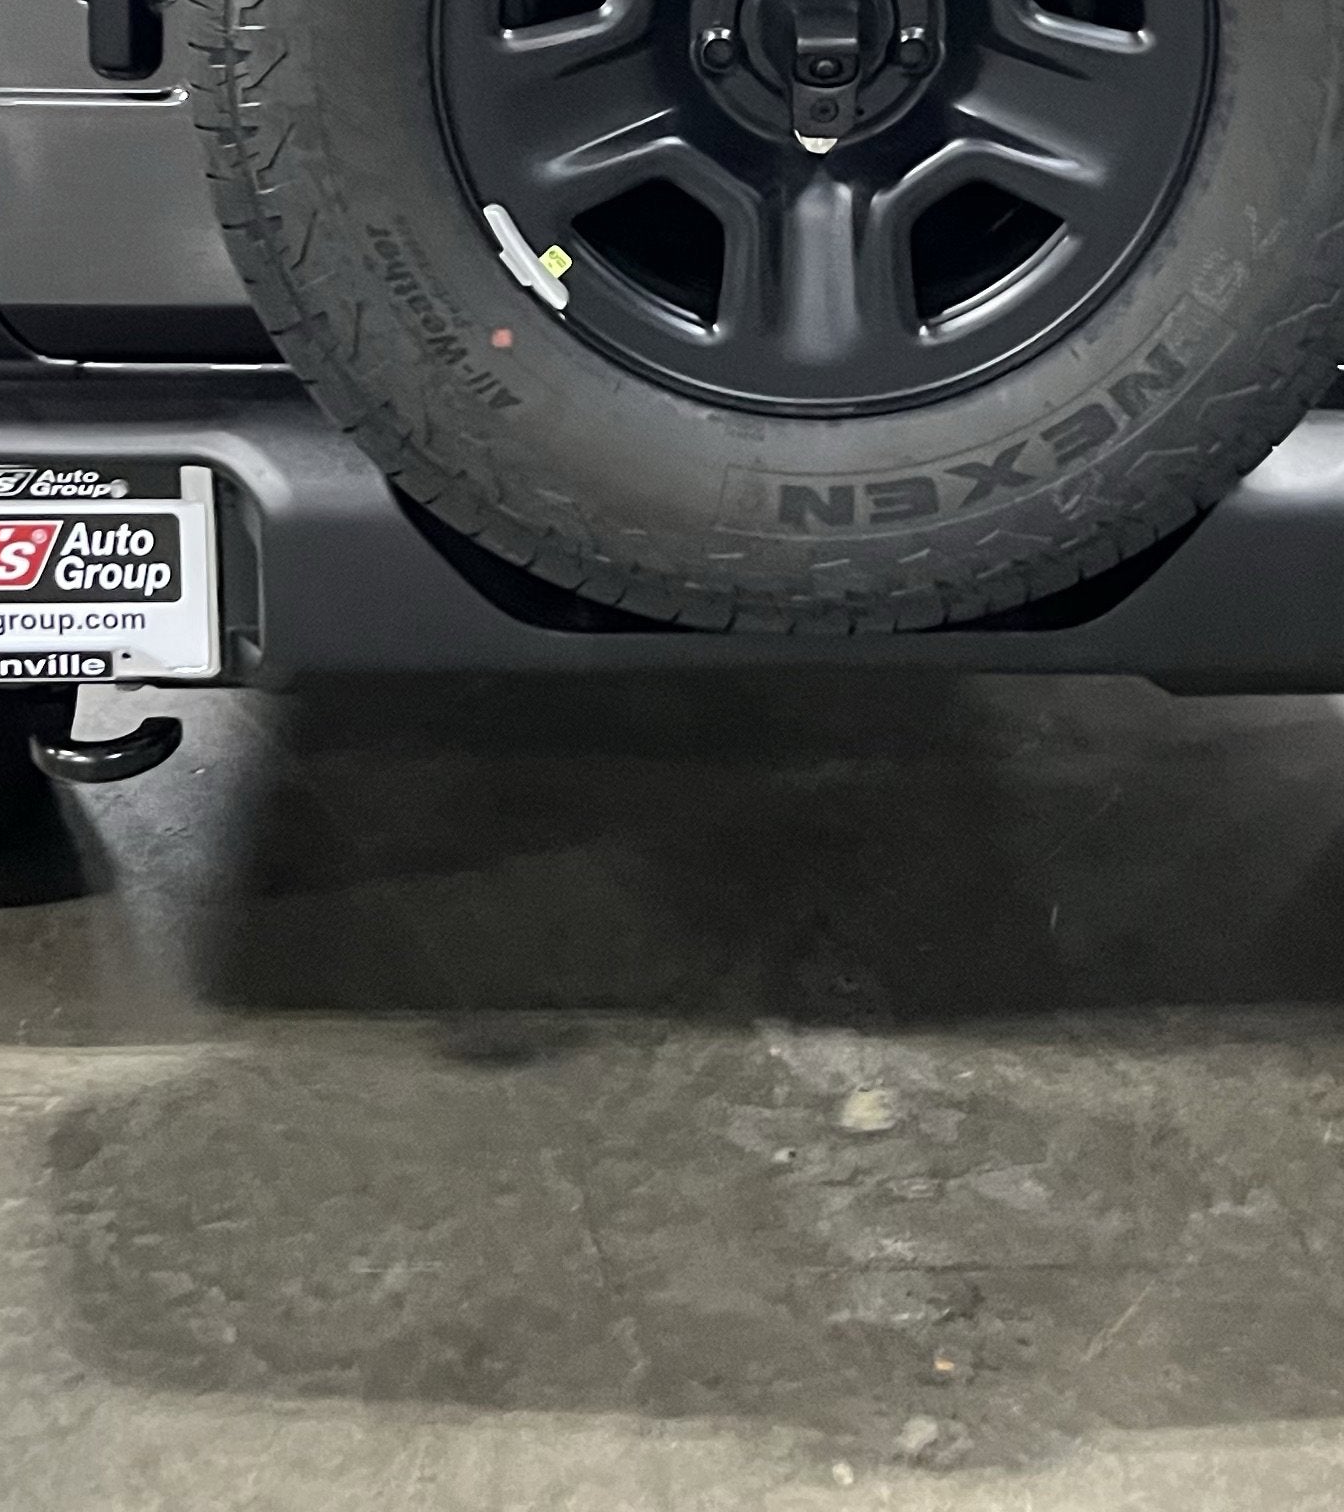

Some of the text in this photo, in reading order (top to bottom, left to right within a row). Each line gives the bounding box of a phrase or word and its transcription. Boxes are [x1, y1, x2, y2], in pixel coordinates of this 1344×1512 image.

[778, 343, 1188, 527] NEXEN
[30, 481, 111, 498] Group
[37, 469, 99, 483] Auto
[60, 522, 155, 557] Auto
[55, 557, 172, 596] Group
